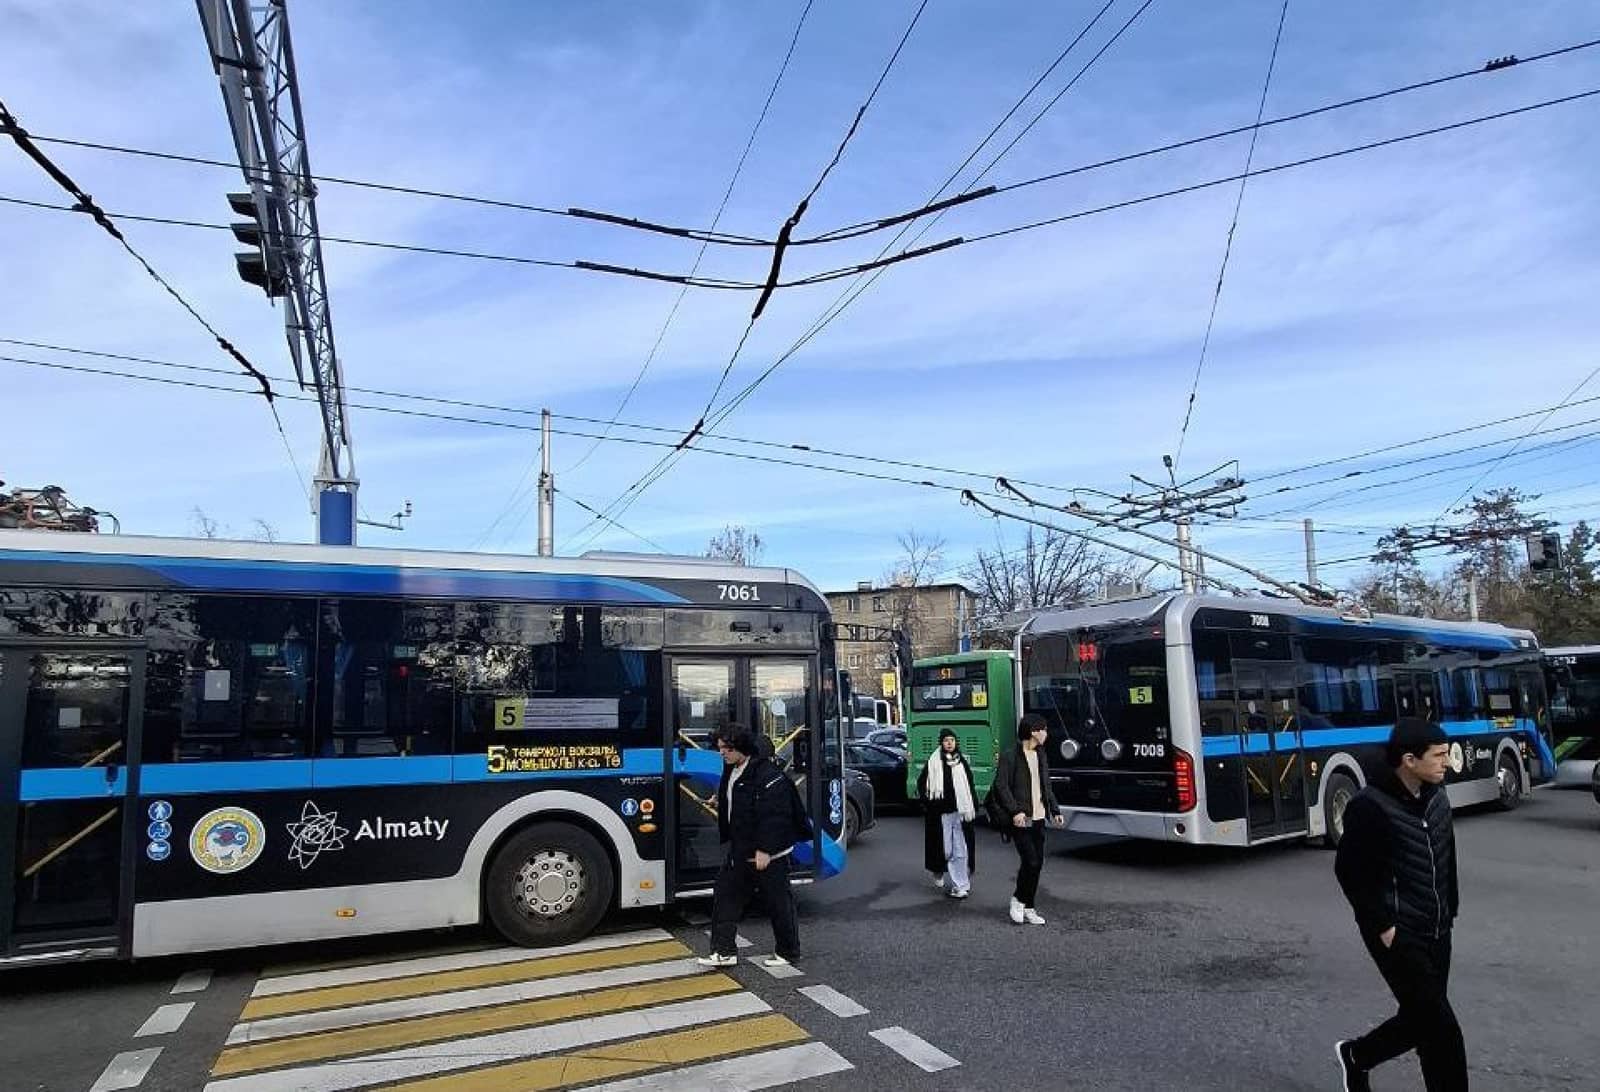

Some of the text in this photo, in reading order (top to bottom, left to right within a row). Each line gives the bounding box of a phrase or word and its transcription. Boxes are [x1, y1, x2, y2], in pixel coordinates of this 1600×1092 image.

[717, 584, 761, 601] 7061
[1137, 688, 1146, 703] 5
[502, 706, 517, 726] 5
[487, 745, 506, 772] 5
[354, 816, 449, 841] Almaty
